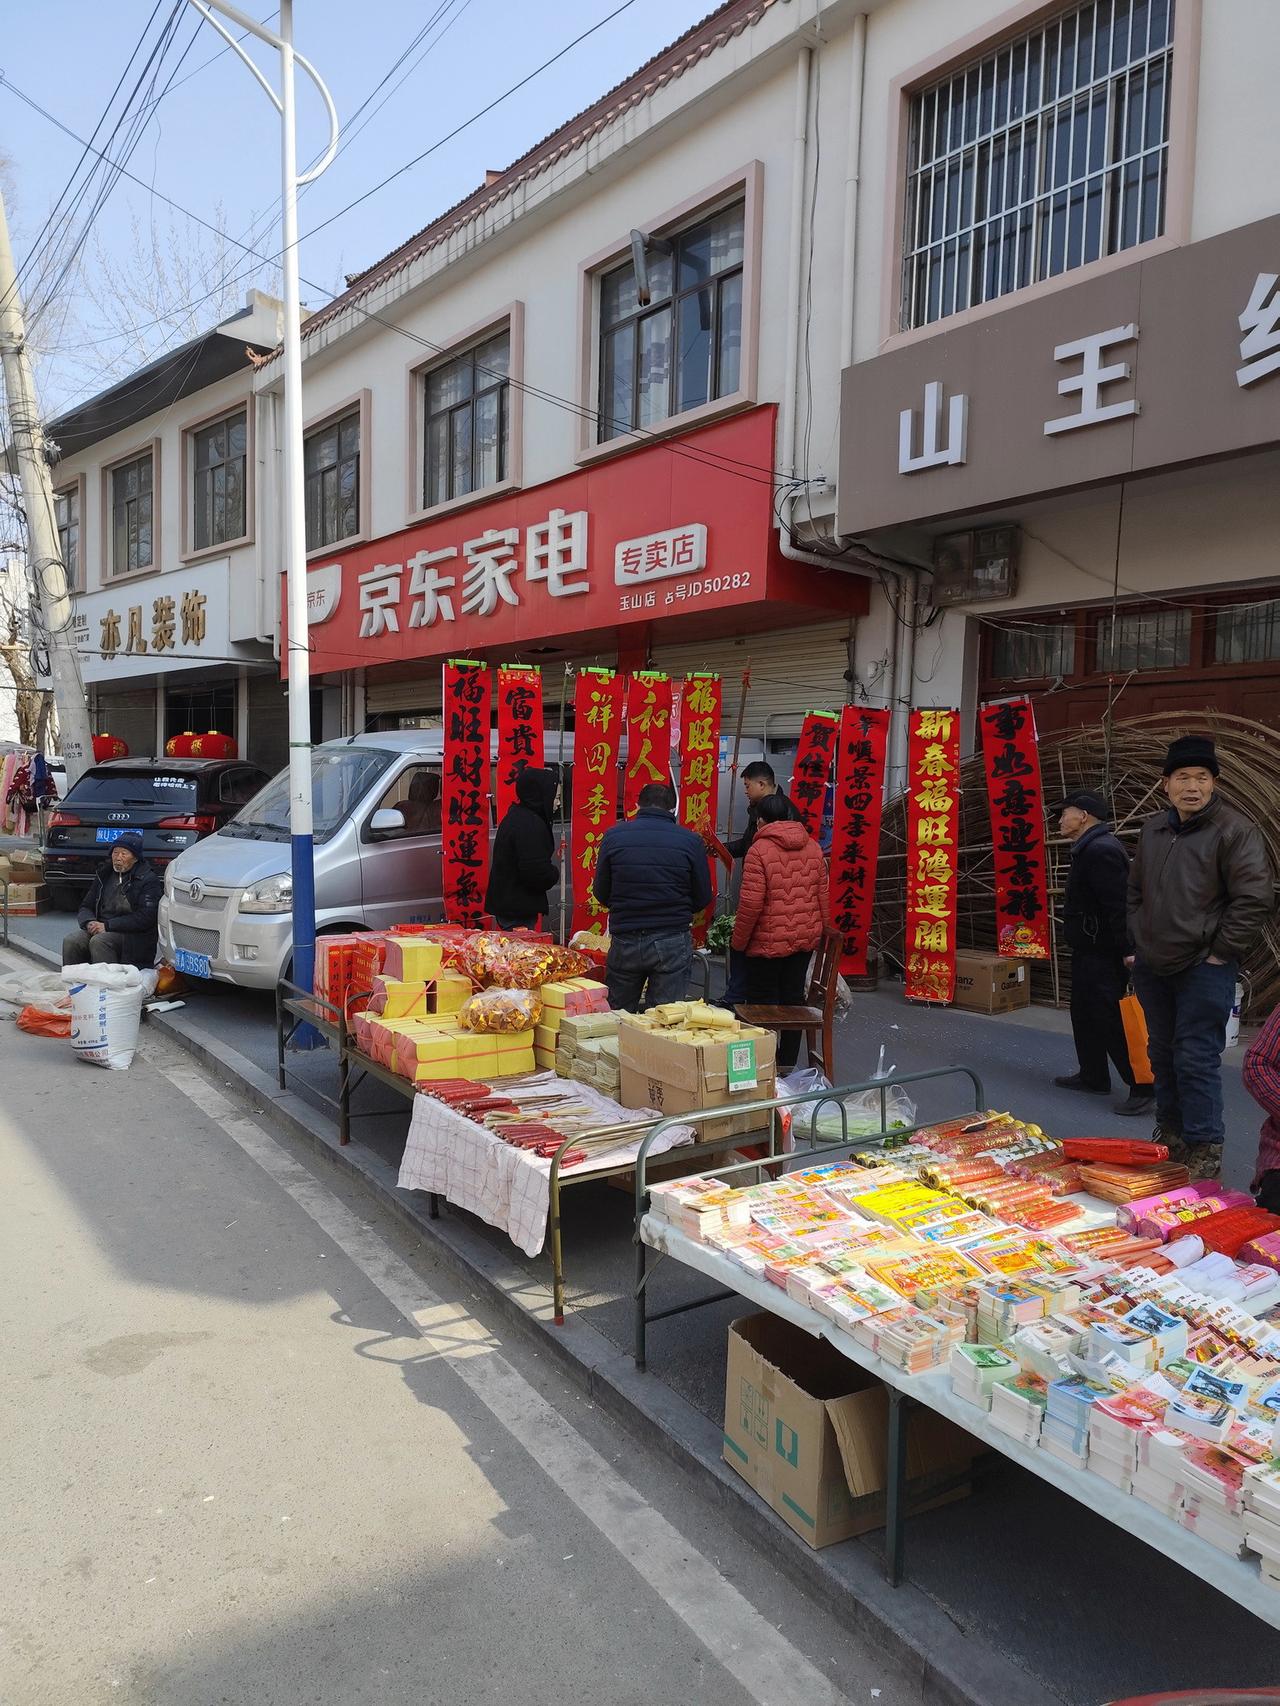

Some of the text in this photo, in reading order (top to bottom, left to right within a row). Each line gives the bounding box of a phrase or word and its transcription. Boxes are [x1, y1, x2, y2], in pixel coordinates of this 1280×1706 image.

[358, 508, 590, 638] 京东家电
[622, 534, 695, 575] 专卖店
[306, 588, 326, 608] 京东
[619, 591, 656, 611] 玉山店
[914, 710, 955, 953] 新春福旺鴻運開
